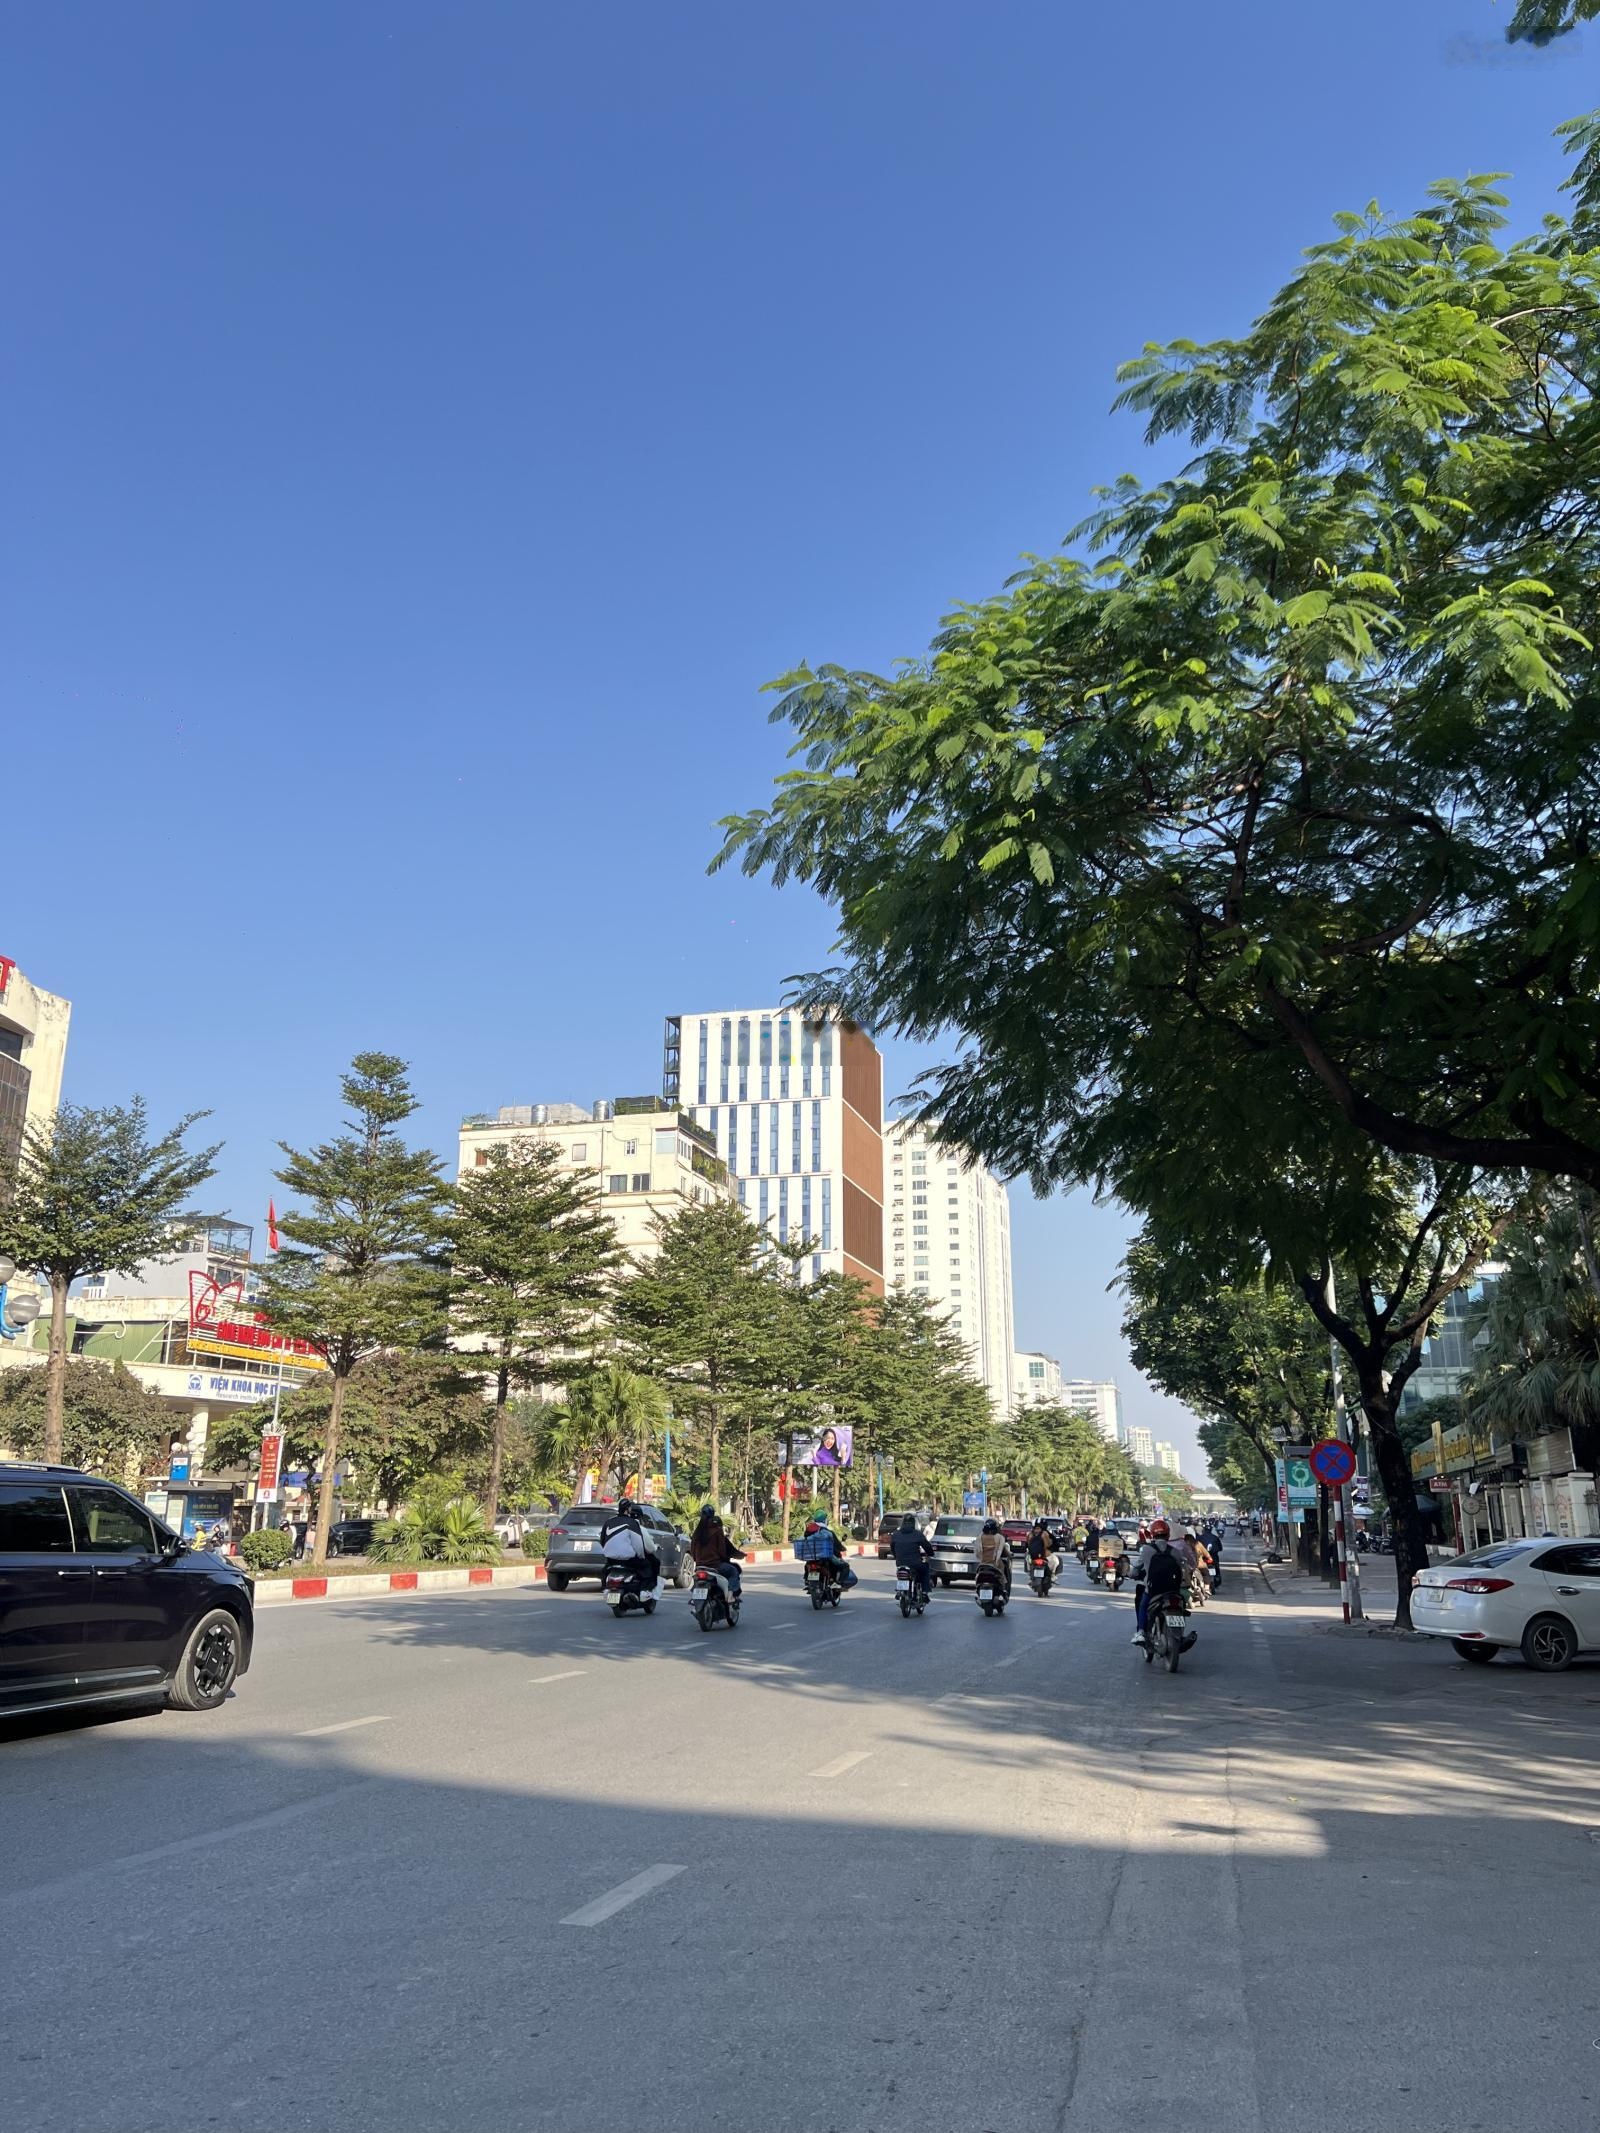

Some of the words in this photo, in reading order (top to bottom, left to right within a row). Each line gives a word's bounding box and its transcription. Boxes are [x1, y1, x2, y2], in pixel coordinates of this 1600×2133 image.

[210, 1376, 229, 1392] VIỆN
[231, 1380, 252, 1392] KHOA
[254, 1381, 269, 1396] HỌC
